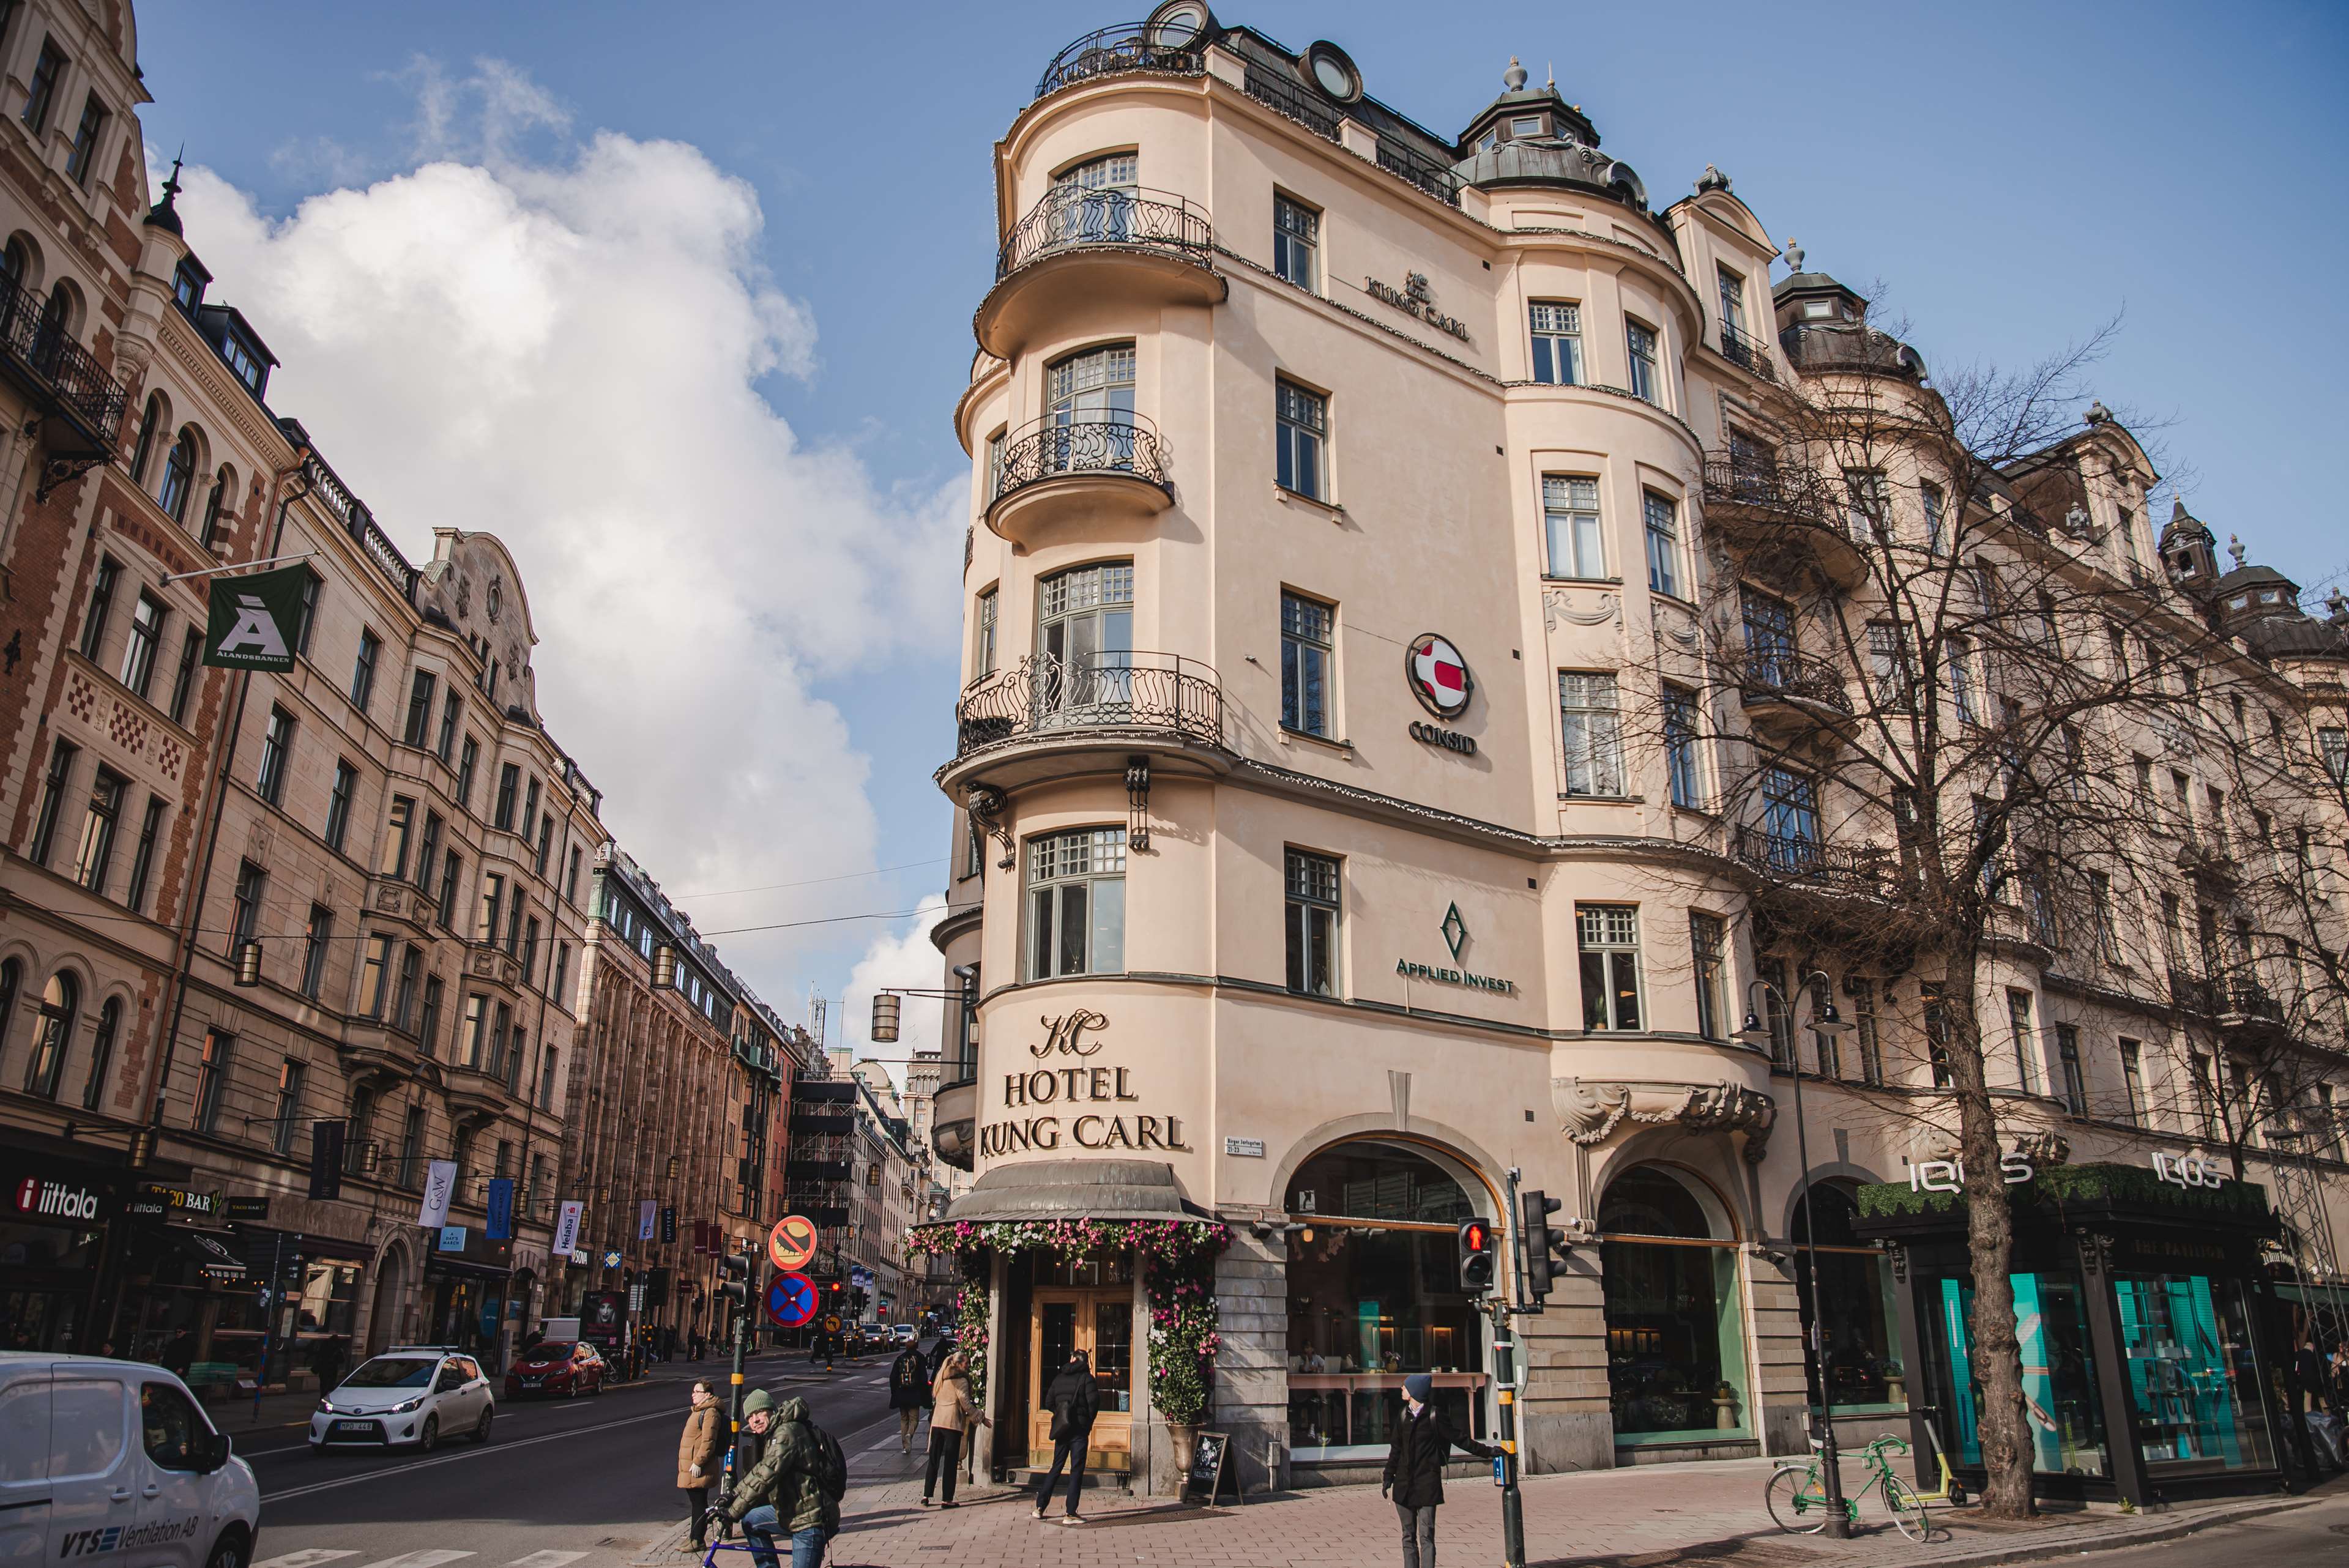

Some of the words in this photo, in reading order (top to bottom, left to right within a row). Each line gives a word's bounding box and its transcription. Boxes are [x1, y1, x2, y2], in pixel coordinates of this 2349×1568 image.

[1364, 276, 1420, 317] KUNG
[1424, 305, 1470, 342] CARL
[1409, 721, 1478, 754] CONSID
[1396, 958, 1459, 983] APPLIED
[1462, 969, 1514, 992] INVEST
[1003, 1066, 1134, 1105] HOTEL
[980, 1116, 1058, 1156] KUNG
[1072, 1113, 1185, 1148] CARL
[1909, 1152, 2034, 1194] IQS
[2151, 1151, 2222, 1190] IQOS
[38, 1181, 99, 1219] iittala
[133, 1203, 163, 1213] iittala
[185, 1192, 210, 1212] BAR
[430, 1175, 445, 1211] G&W
[561, 1218, 573, 1249] Helaba
[575, 1249, 587, 1265] SOVA
[60, 1528, 104, 1558] VTS
[118, 1518, 182, 1548] Ventilation
[179, 1515, 199, 1538] AB
